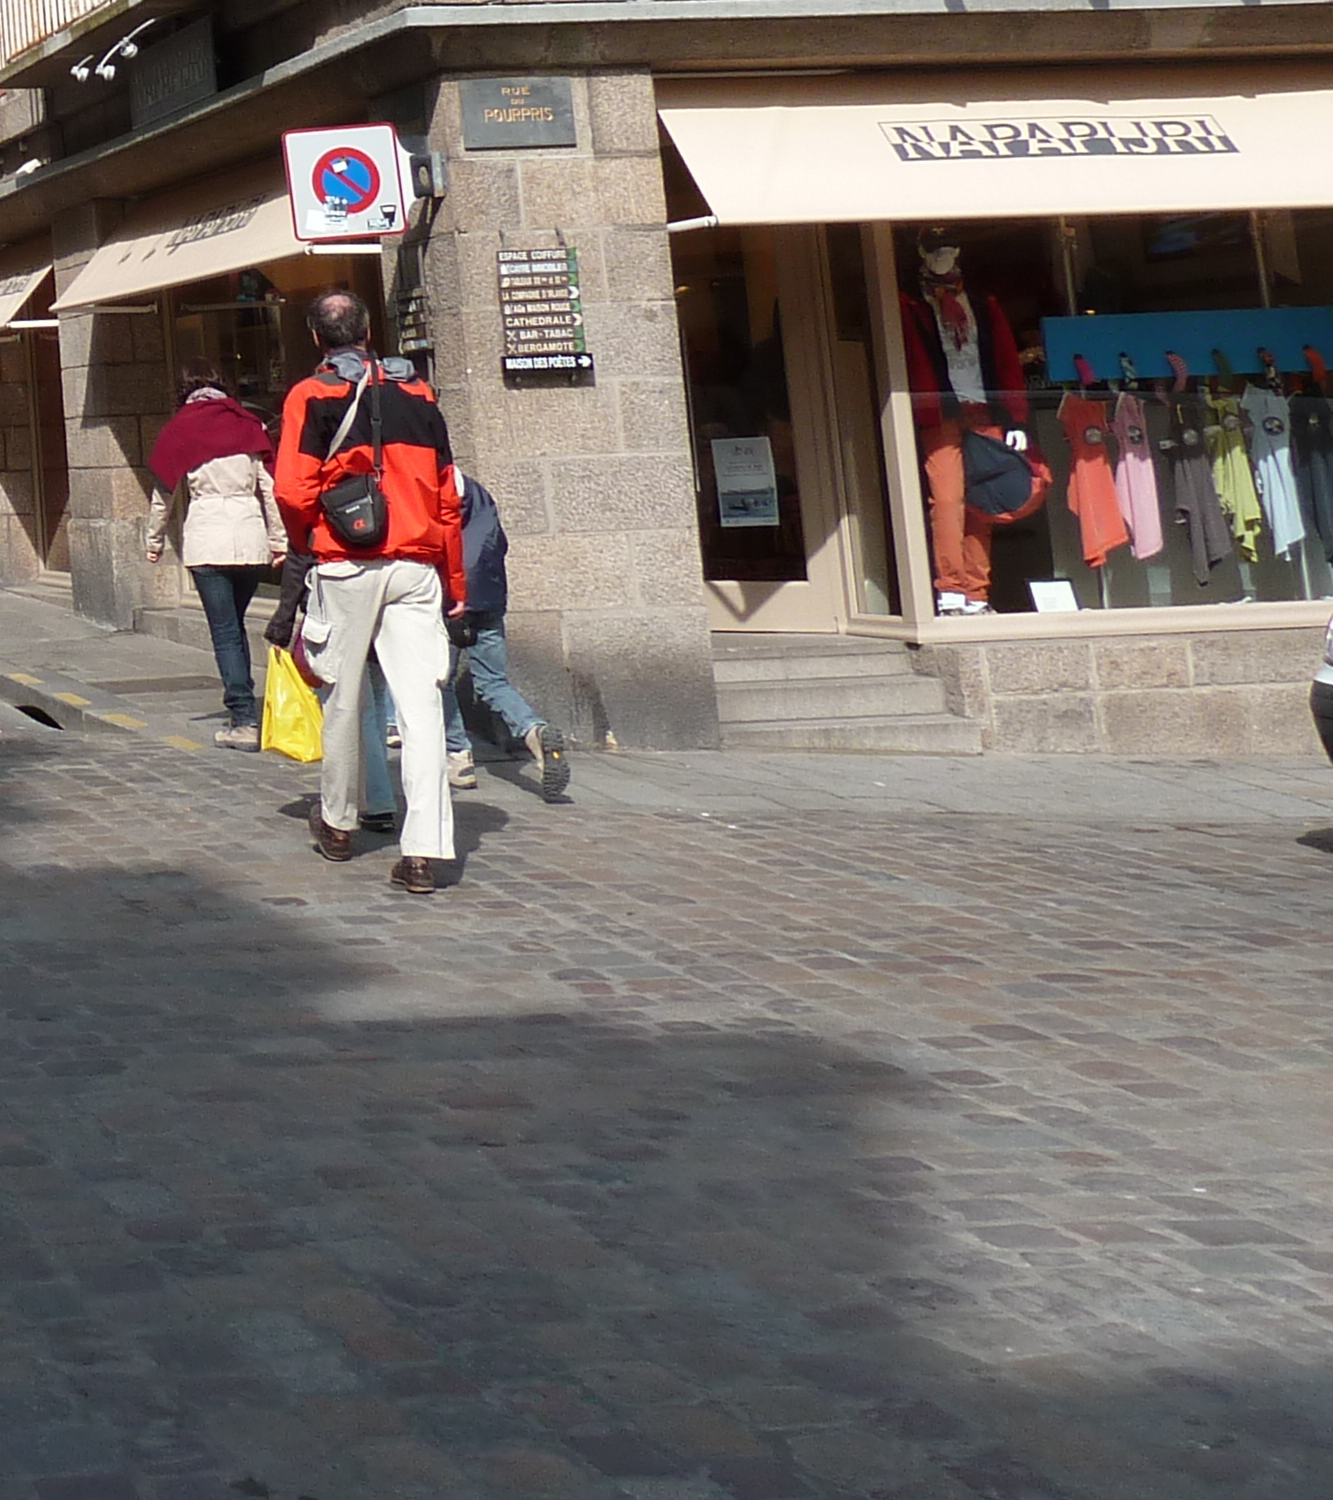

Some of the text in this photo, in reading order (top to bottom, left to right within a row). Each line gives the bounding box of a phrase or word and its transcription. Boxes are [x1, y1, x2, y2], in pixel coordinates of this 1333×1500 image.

[501, 86, 531, 97] RUE
[484, 106, 554, 123] POURPRIS
[891, 119, 1233, 160] NAPAPIJRI
[498, 251, 528, 261] ESPACE
[505, 315, 573, 328] CATHEDRALE
[517, 341, 575, 353] BERGAMOTE
